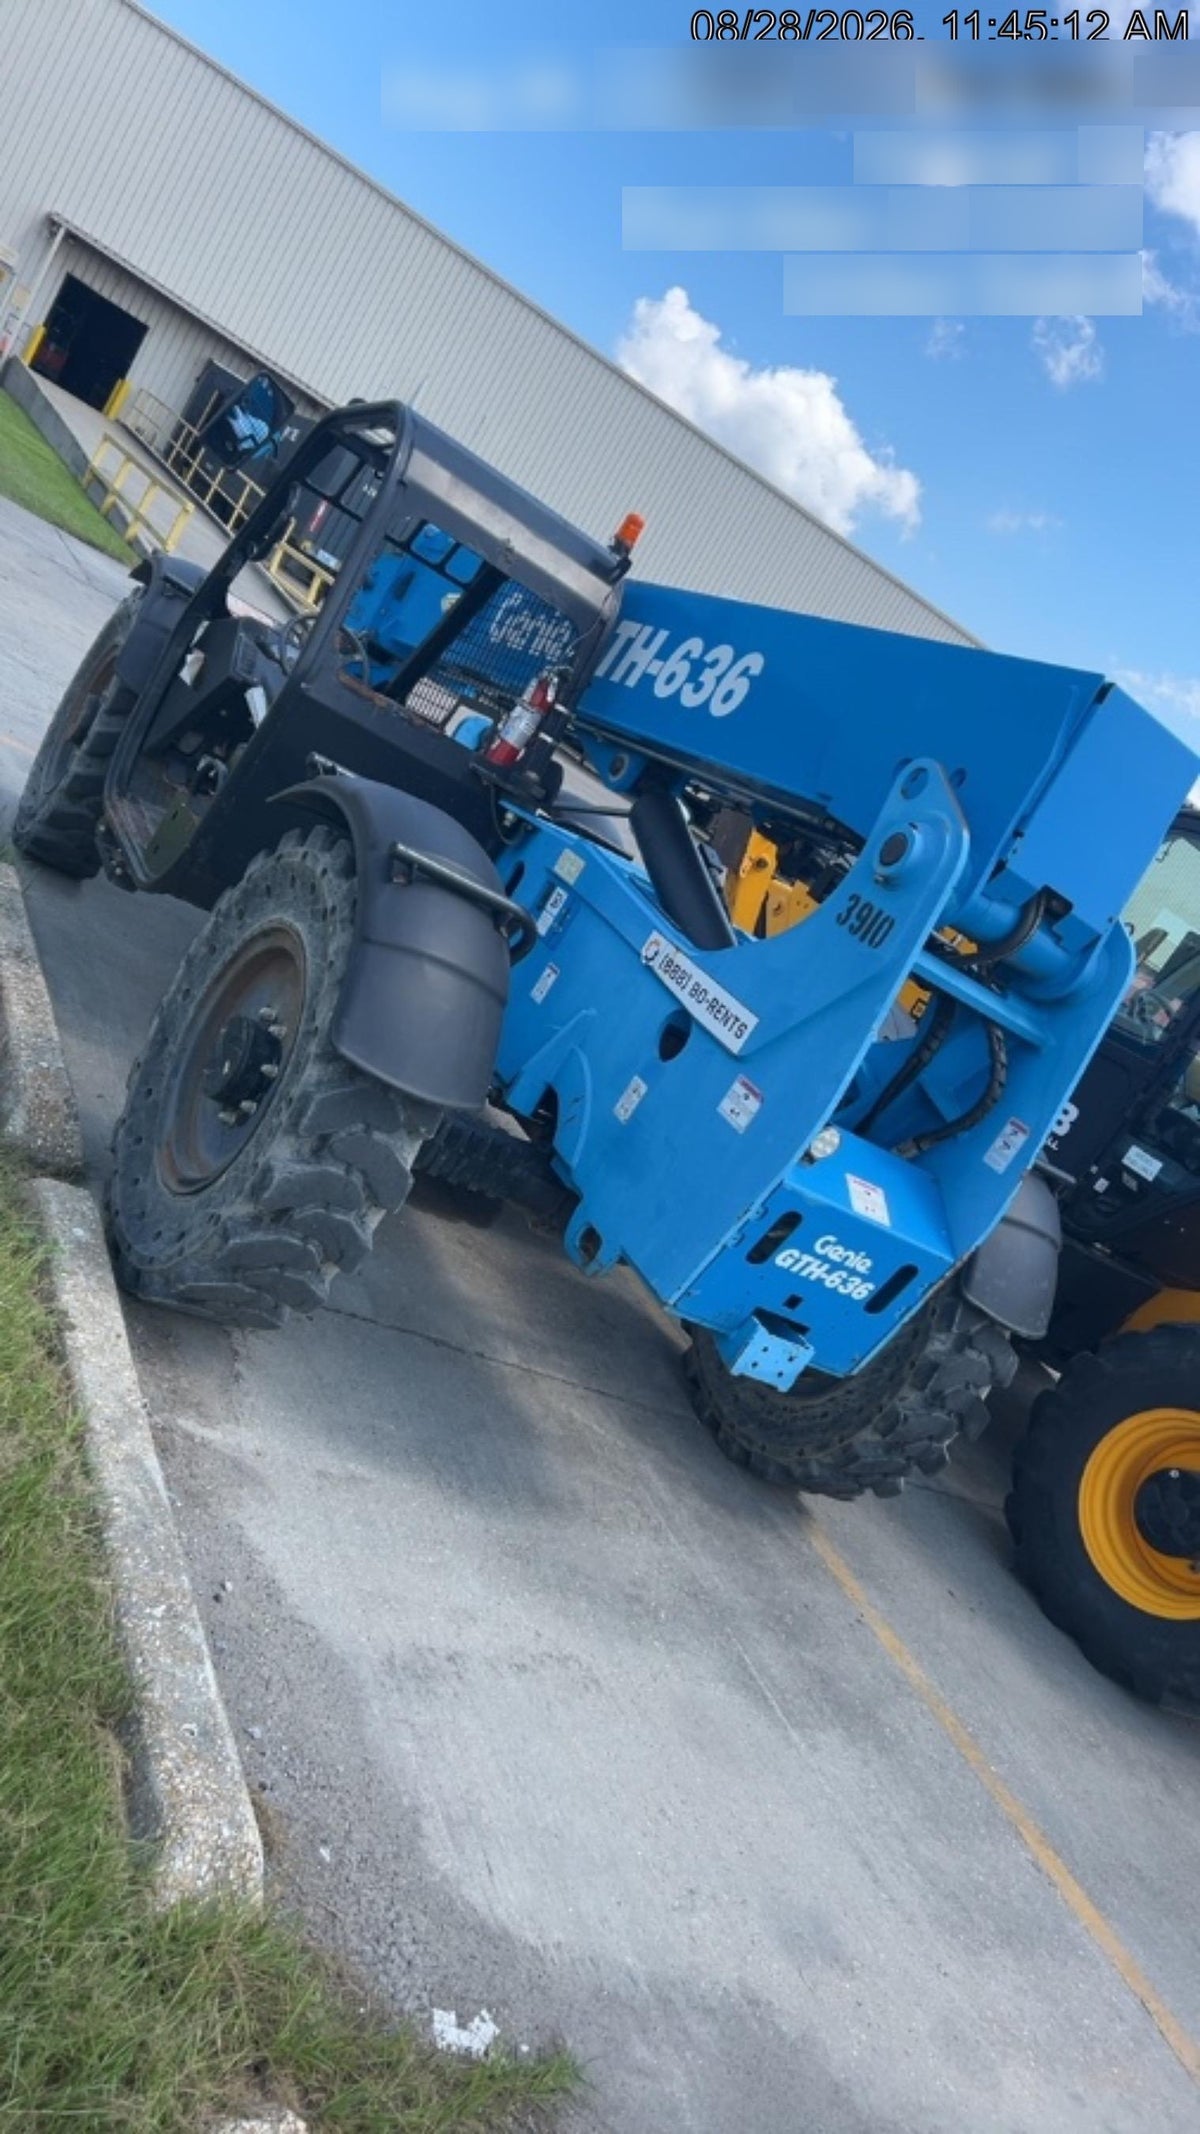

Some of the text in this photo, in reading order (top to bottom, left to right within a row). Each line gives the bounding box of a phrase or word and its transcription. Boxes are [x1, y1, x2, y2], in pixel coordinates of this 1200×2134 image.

[594, 620, 765, 717] TH-636
[836, 893, 895, 949] 3910
[659, 953, 692, 991] (888)
[775, 1249, 875, 1300] GTH-636
[814, 1235, 872, 1275] Genie
